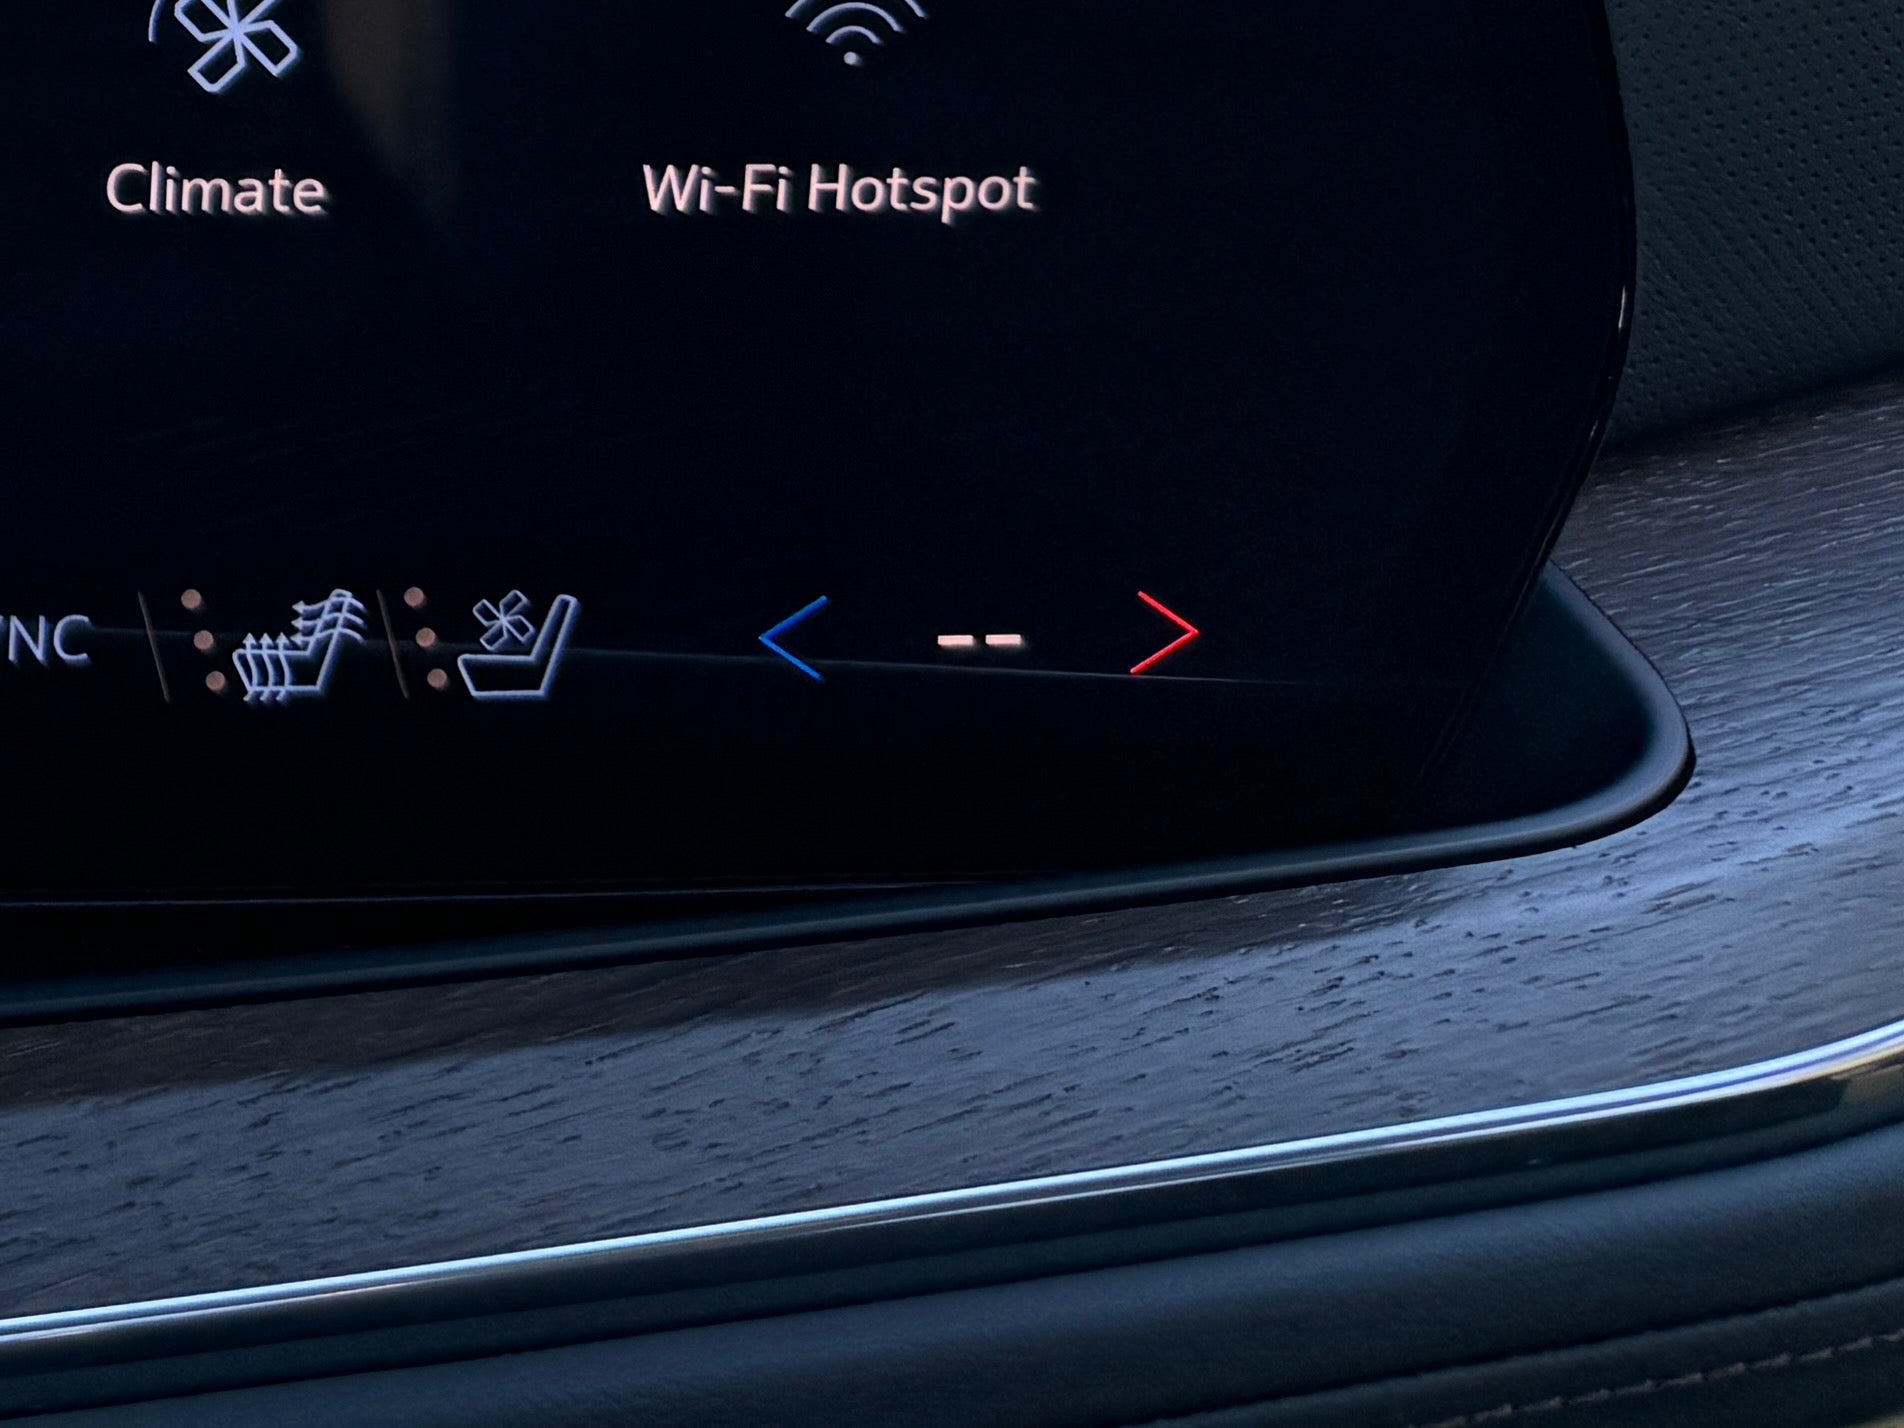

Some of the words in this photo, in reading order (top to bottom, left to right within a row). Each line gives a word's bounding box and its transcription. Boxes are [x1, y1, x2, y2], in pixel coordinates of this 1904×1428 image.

[106, 160, 326, 215] Climate
[642, 163, 790, 213] Wi-Fi
[808, 163, 1036, 225] Hotspot
